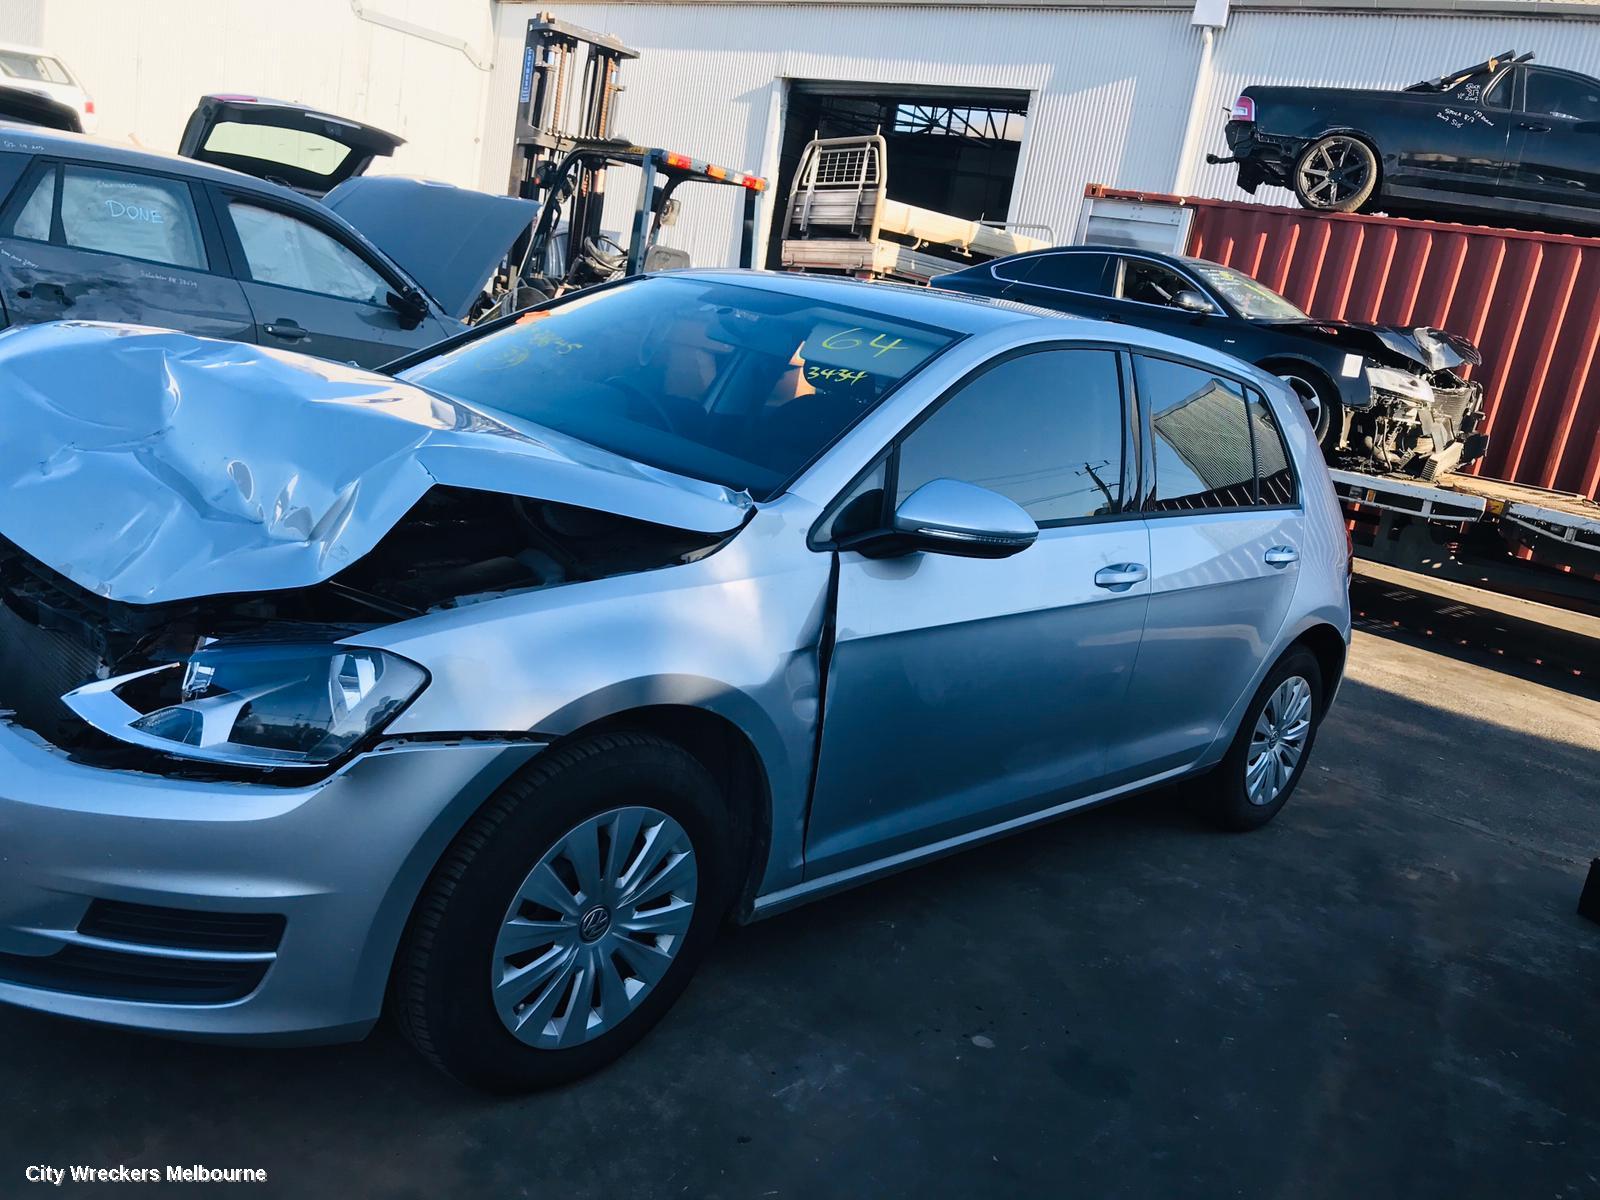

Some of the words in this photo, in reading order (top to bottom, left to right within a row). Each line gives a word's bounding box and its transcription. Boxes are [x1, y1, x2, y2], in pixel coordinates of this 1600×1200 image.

[105, 200, 164, 224] DONE
[822, 327, 911, 358] 64
[807, 366, 869, 386] 3434
